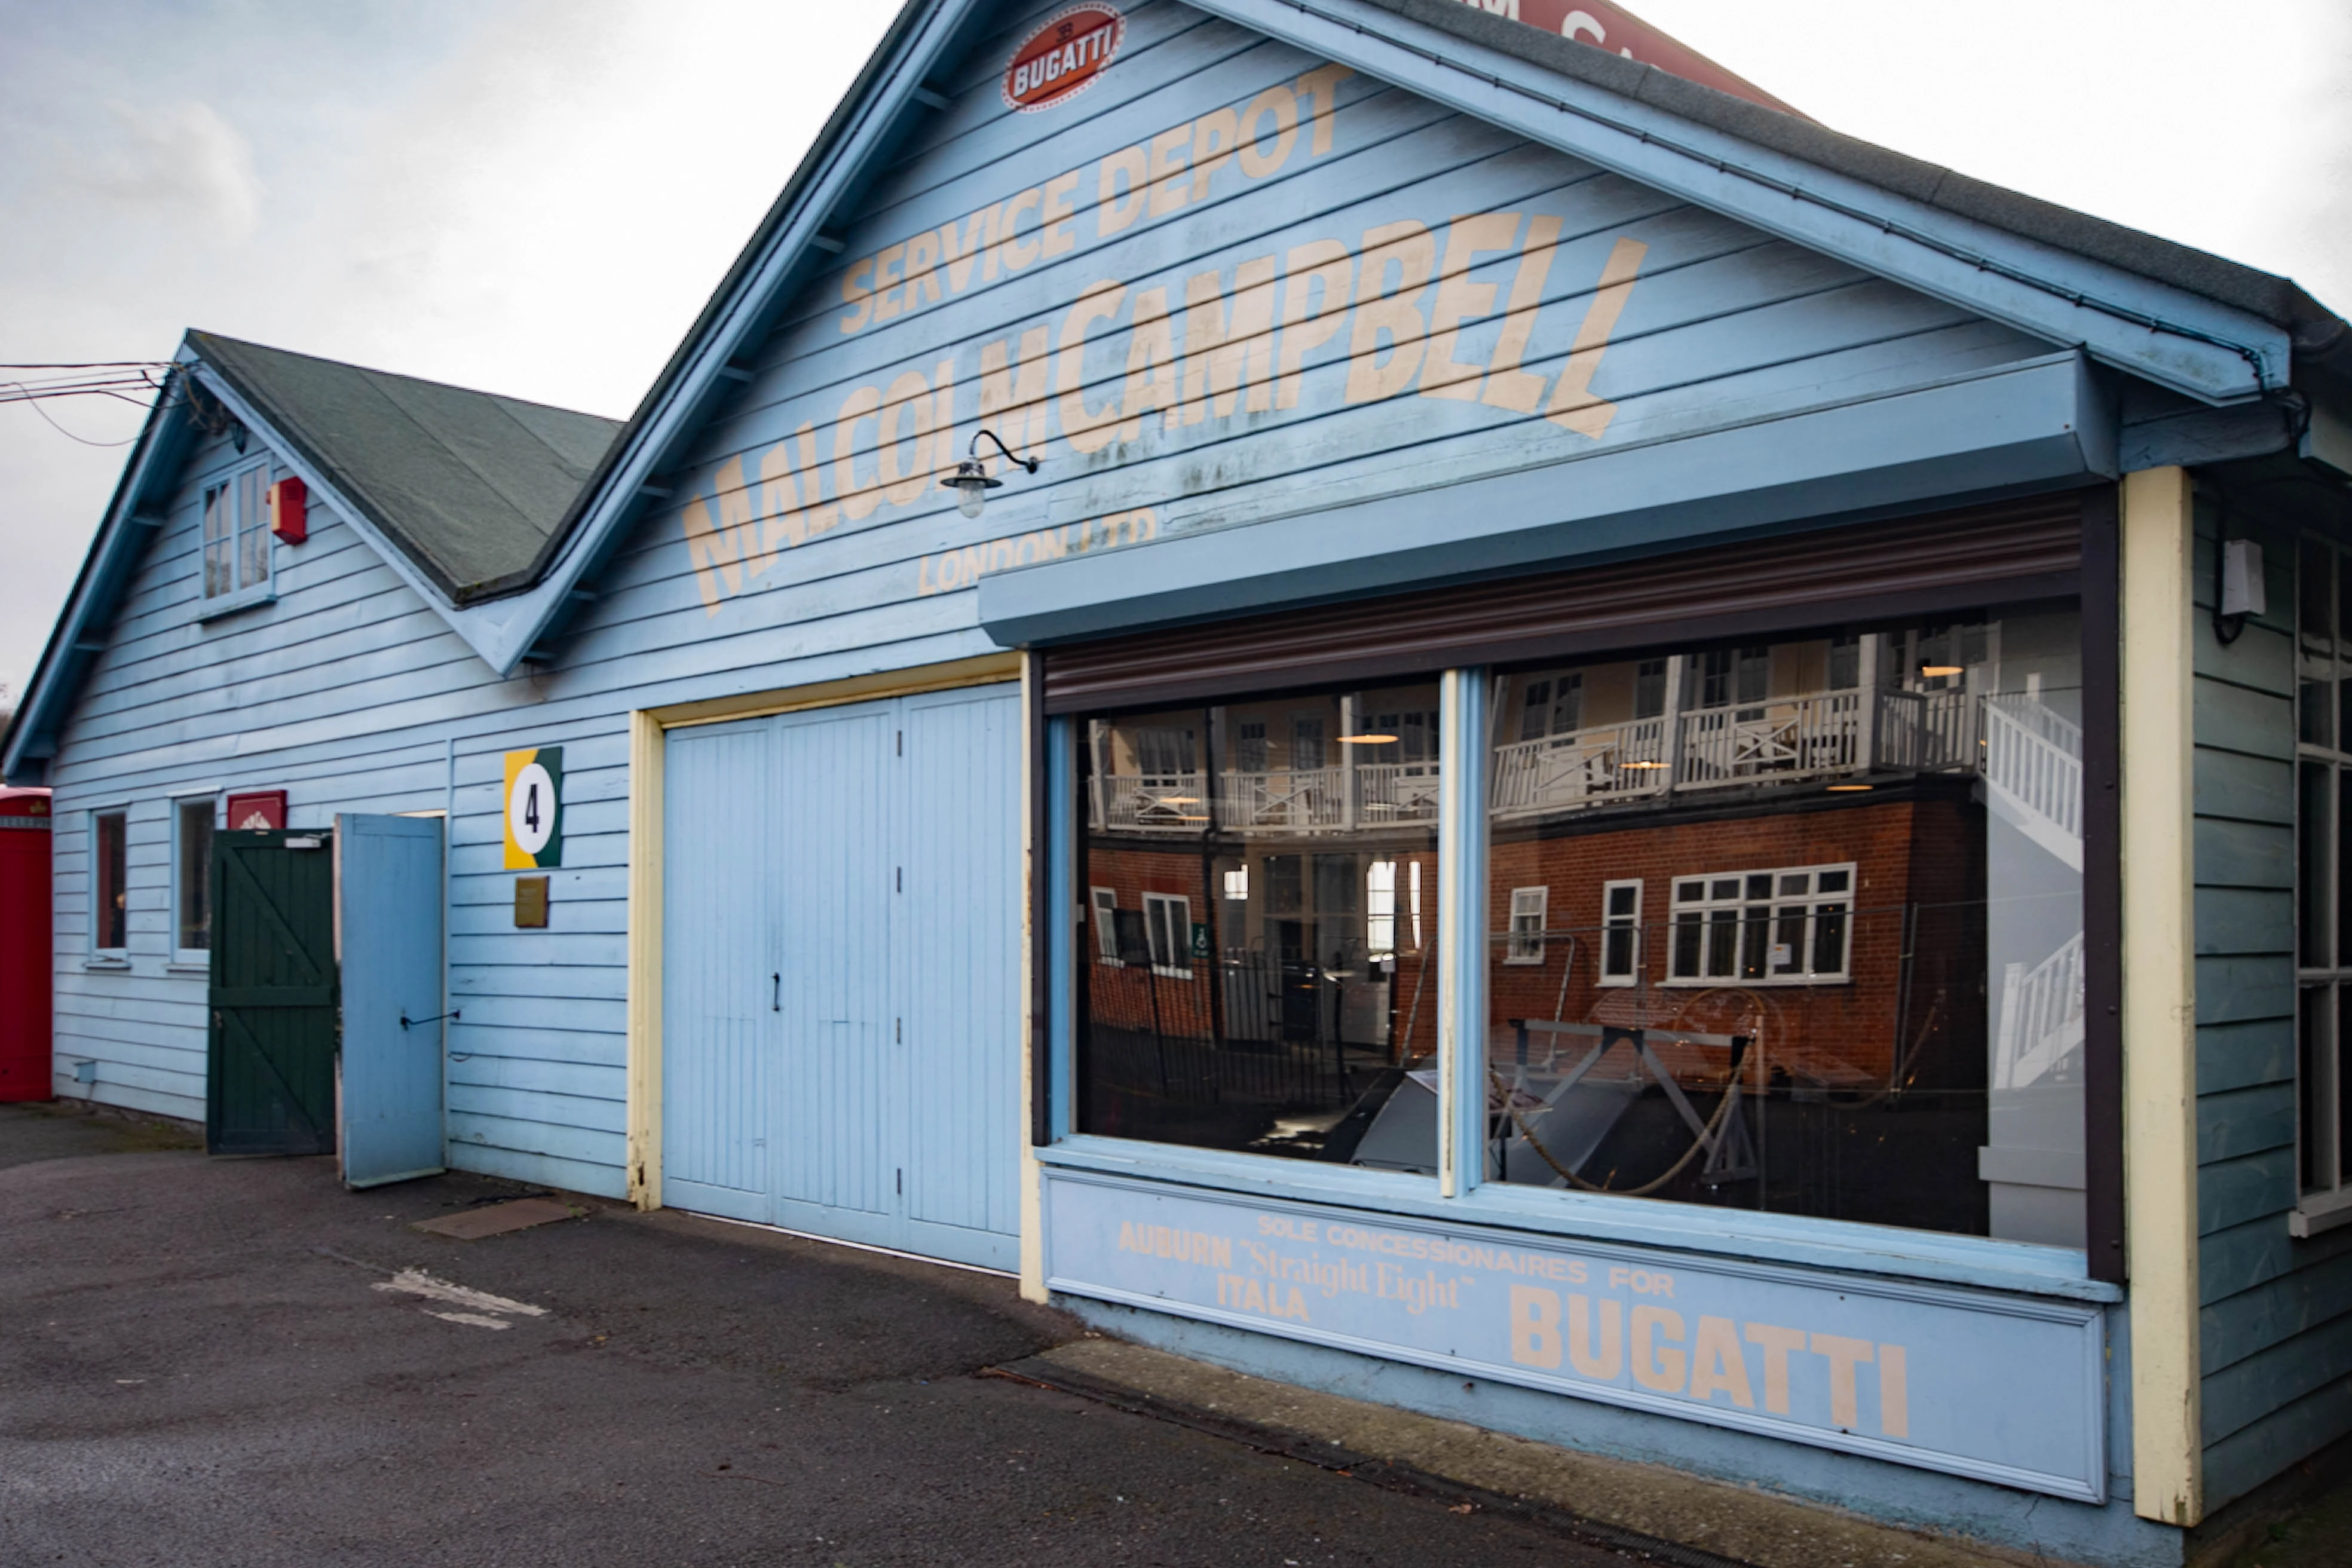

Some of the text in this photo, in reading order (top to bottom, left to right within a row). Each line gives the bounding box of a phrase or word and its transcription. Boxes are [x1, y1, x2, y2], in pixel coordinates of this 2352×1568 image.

[1013, 24, 1113, 97] BUGATTI
[840, 63, 1354, 335] SERVICE DEPOT
[682, 213, 1647, 619] MALCOLM CAMPBELL
[918, 525, 1070, 596] LONDON
[525, 784, 540, 833] 4
[1119, 1221, 1231, 1270] AUBURN
[1258, 1215, 1674, 1298] SOLE CONCESSIONAIRES FOR
[1217, 1273, 1310, 1321] ITALA
[1509, 1284, 1908, 1438] BUGATTI
